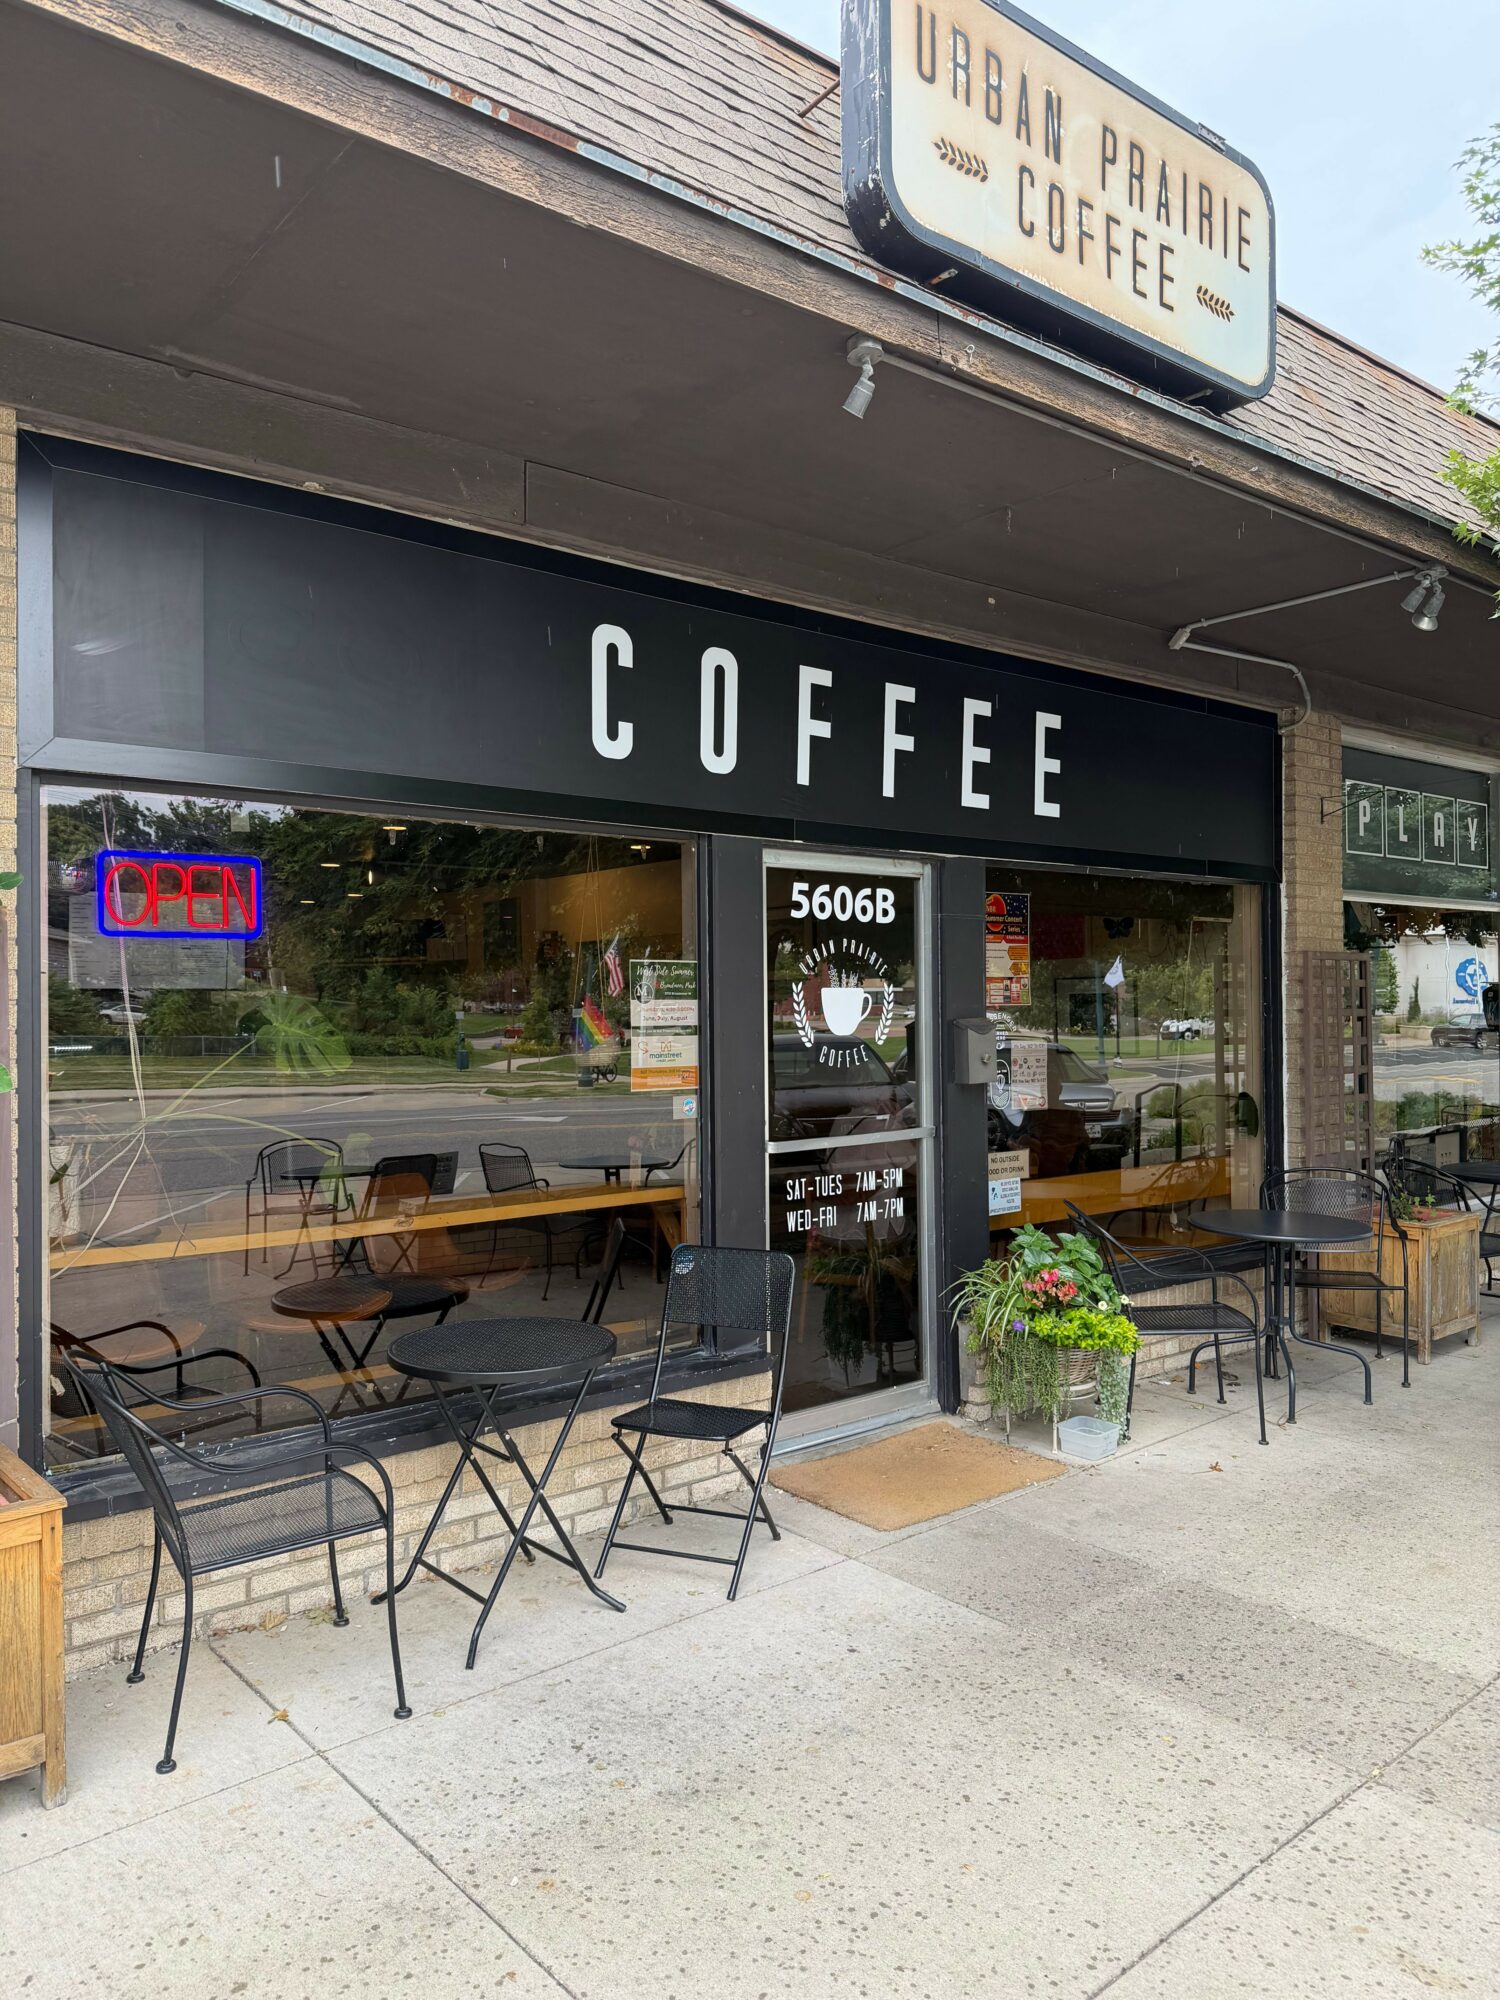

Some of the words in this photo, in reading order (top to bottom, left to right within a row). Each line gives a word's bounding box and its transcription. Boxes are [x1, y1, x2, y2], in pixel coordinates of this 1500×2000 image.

[917, 4, 1061, 165] URBAN
[1101, 124, 1250, 273] PRAIRIE
[1017, 164, 1175, 312] COFFEE
[592, 623, 1062, 818] COFFEE
[1359, 800, 1477, 851] PLAY
[105, 862, 257, 930] OPEN
[790, 882, 896, 924] 5606B
[799, 939, 835, 975] URBAN
[842, 938, 888, 977] PRAIRIE
[649, 1051, 682, 1059] mainstreet
[819, 1044, 869, 1068] COFFEE
[999, 1155, 1020, 1163] OUTSIDE
[786, 1174, 843, 1201] SAT-TUES
[855, 1167, 903, 1193] 7AM-5PM
[786, 1205, 837, 1233] WED-FRI
[856, 1197, 904, 1223] 7AM-7PM
